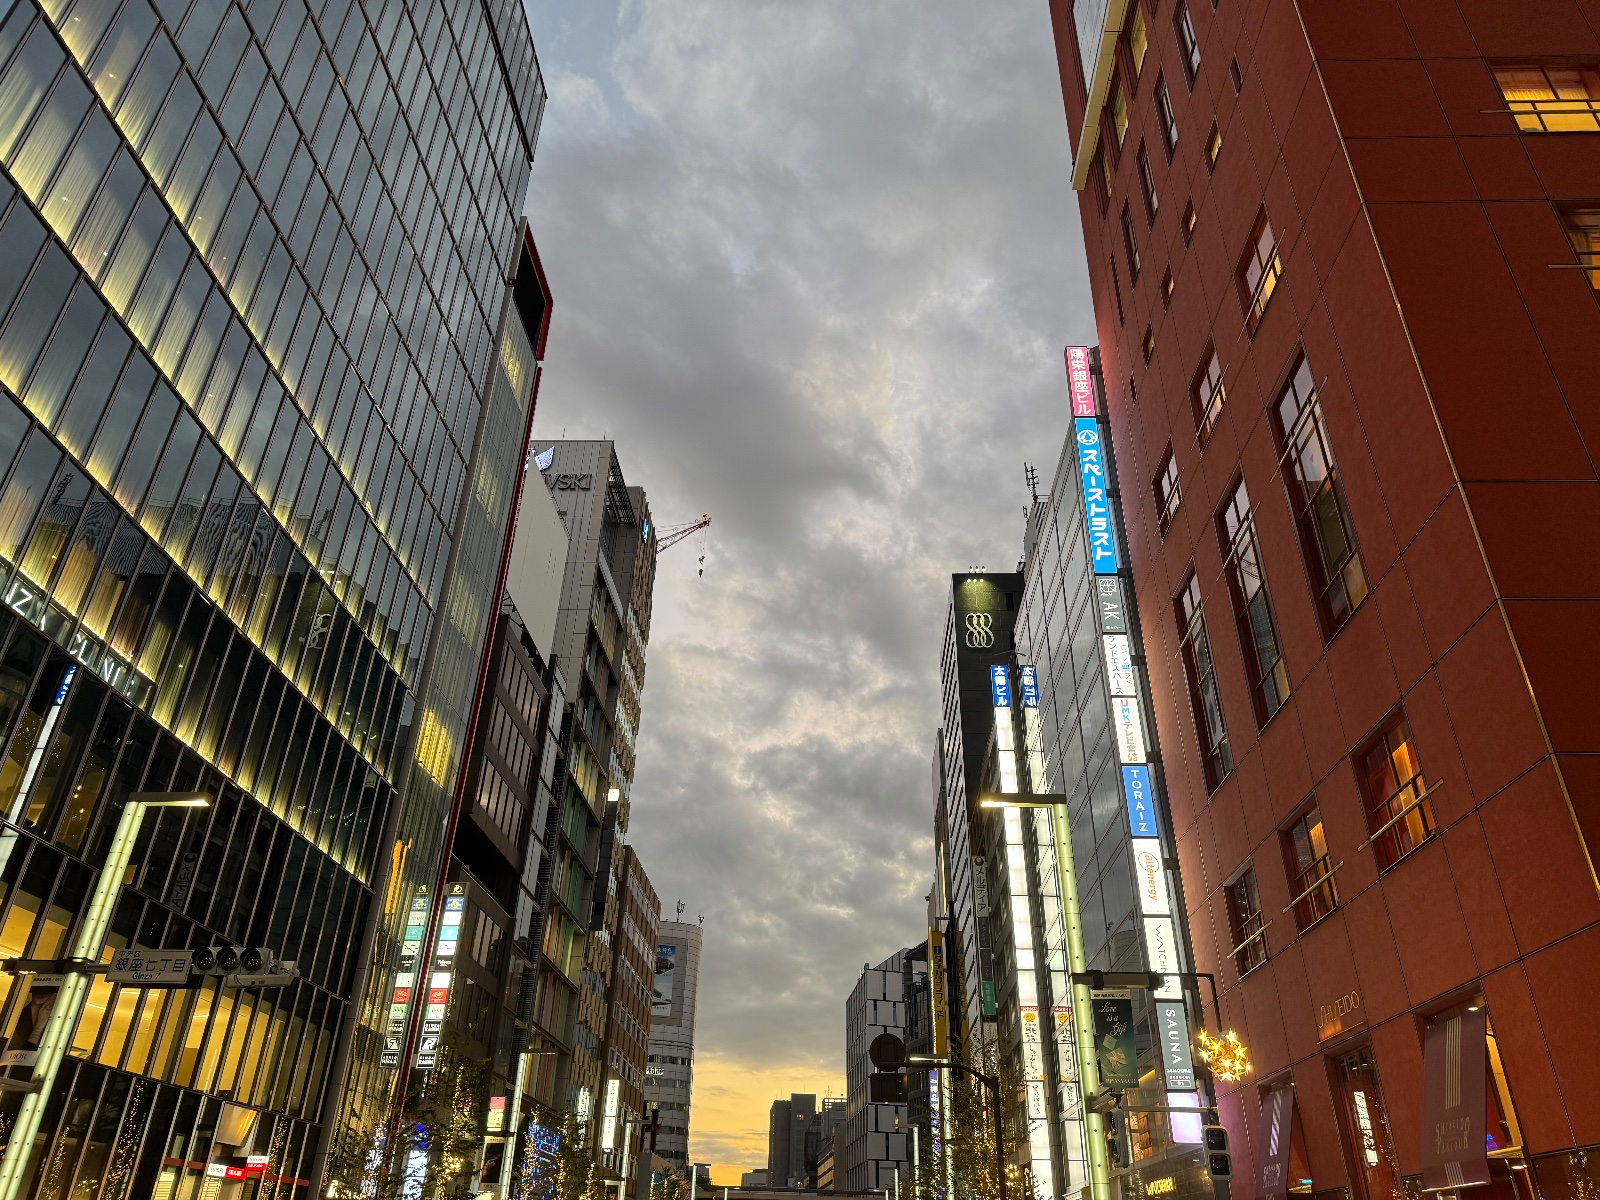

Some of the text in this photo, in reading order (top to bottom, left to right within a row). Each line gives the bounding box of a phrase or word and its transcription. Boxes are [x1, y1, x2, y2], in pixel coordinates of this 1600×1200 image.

[1069, 347, 1092, 415] 陽栄銀座ビル
[1082, 449, 1113, 561] スペーストラスト
[1102, 601, 1121, 620] AK
[1130, 769, 1149, 832] TORAIZ
[1144, 854, 1158, 902] altenergy
[114, 958, 187, 972] 銀座七丁目
[132, 972, 161, 980] Ginza 7
[1098, 1001, 1117, 1013] Love
[1106, 1013, 1113, 1022] is
[1318, 990, 1360, 1029] SHISEIDO
[1165, 1009, 1183, 1065] SAUNA
